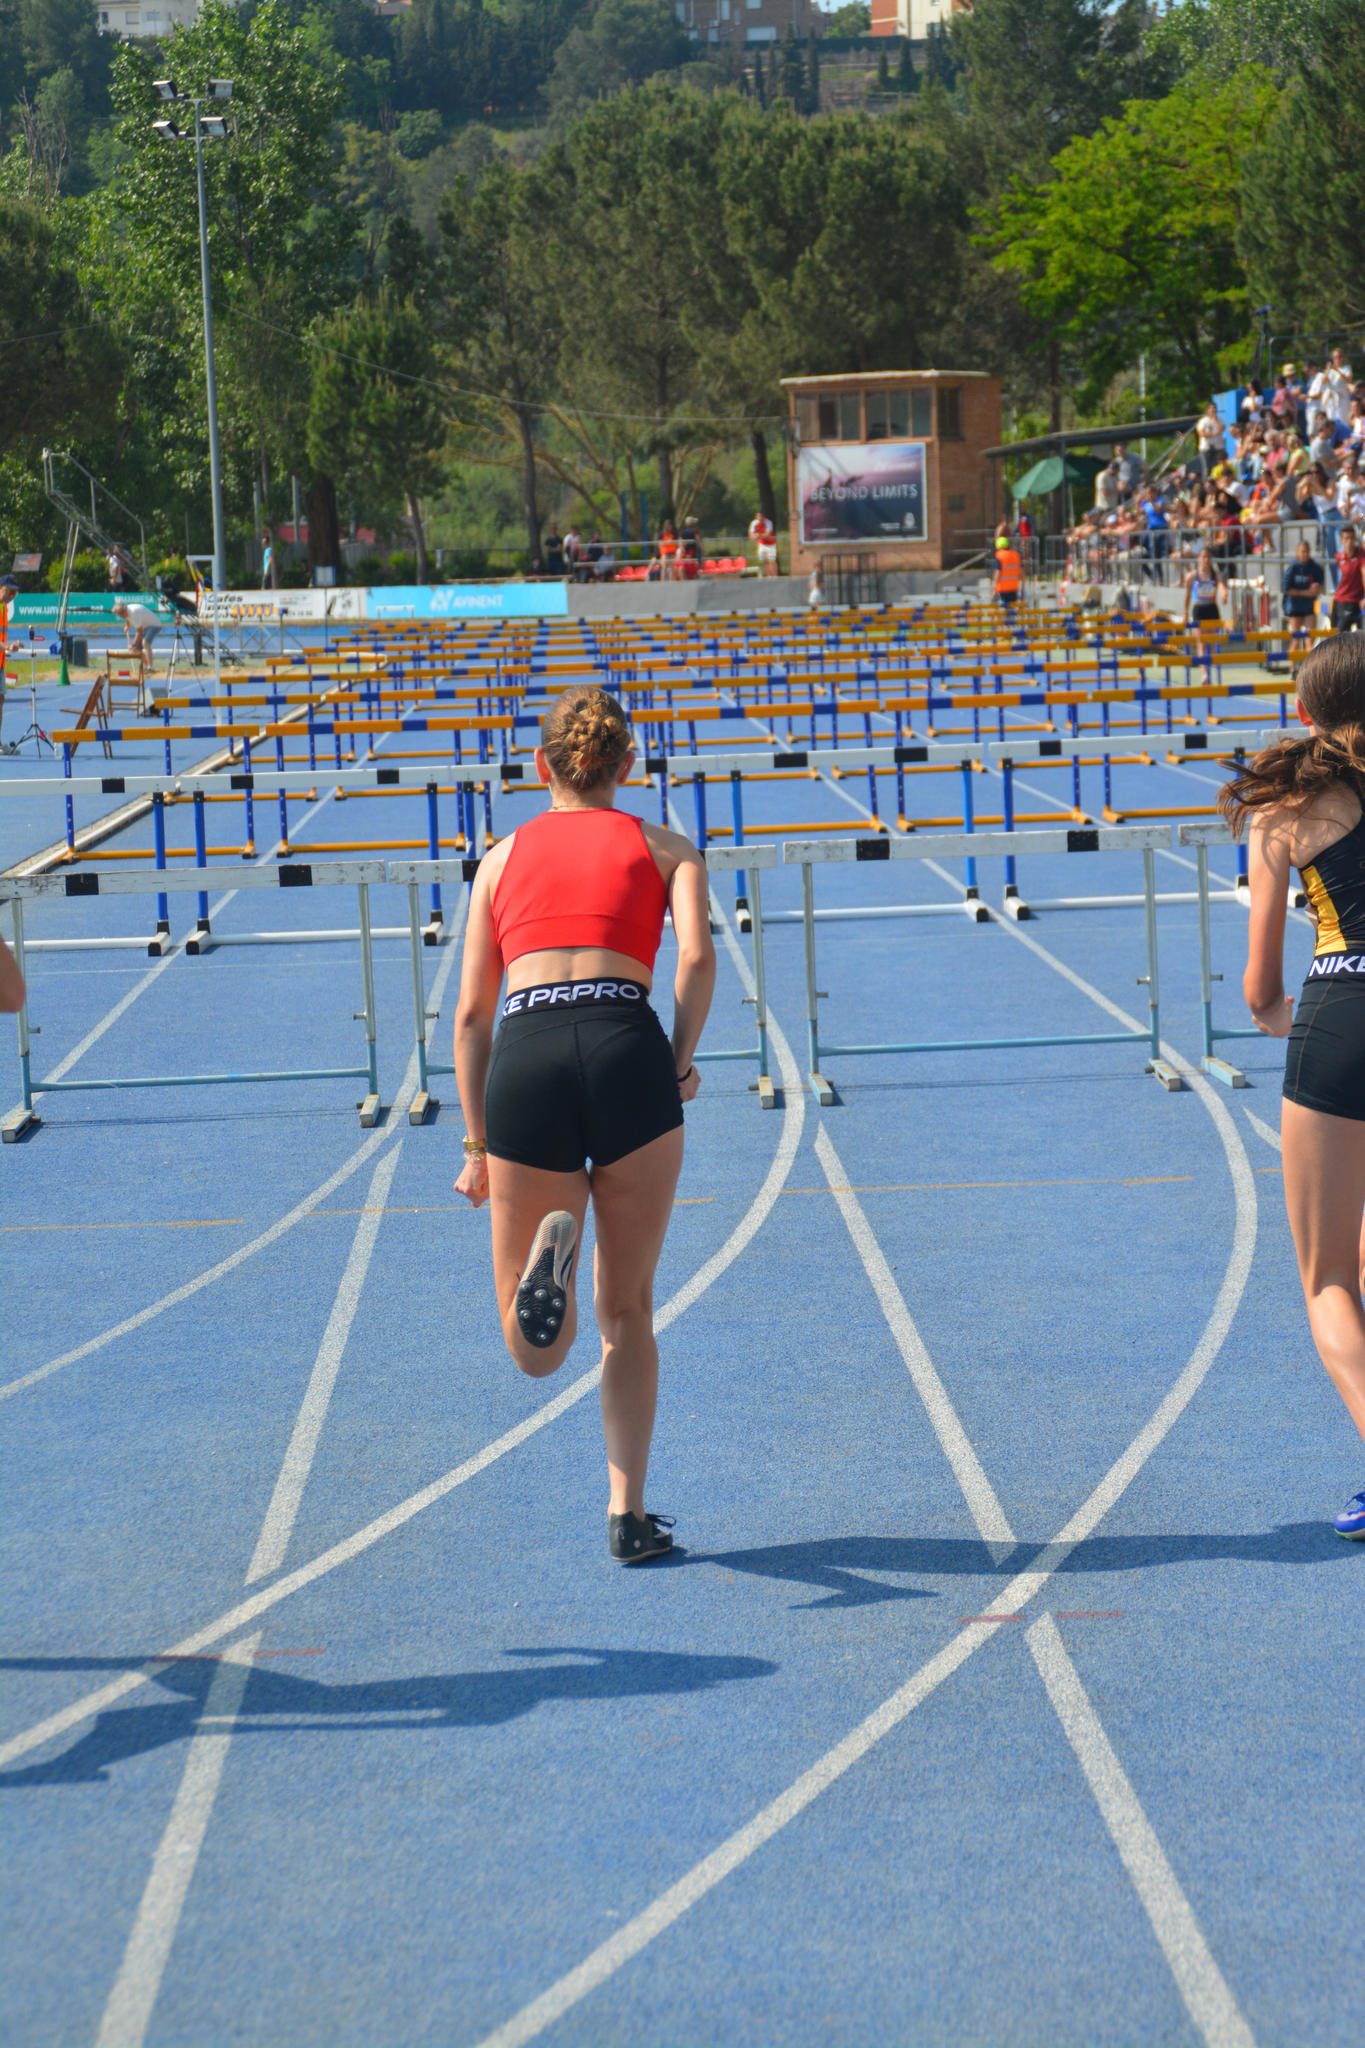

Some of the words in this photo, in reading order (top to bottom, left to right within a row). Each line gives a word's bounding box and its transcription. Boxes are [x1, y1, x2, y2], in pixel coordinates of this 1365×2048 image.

[810, 486, 869, 502] BEYOND
[872, 484, 919, 500] LIMITS
[453, 594, 504, 608] AVINENT
